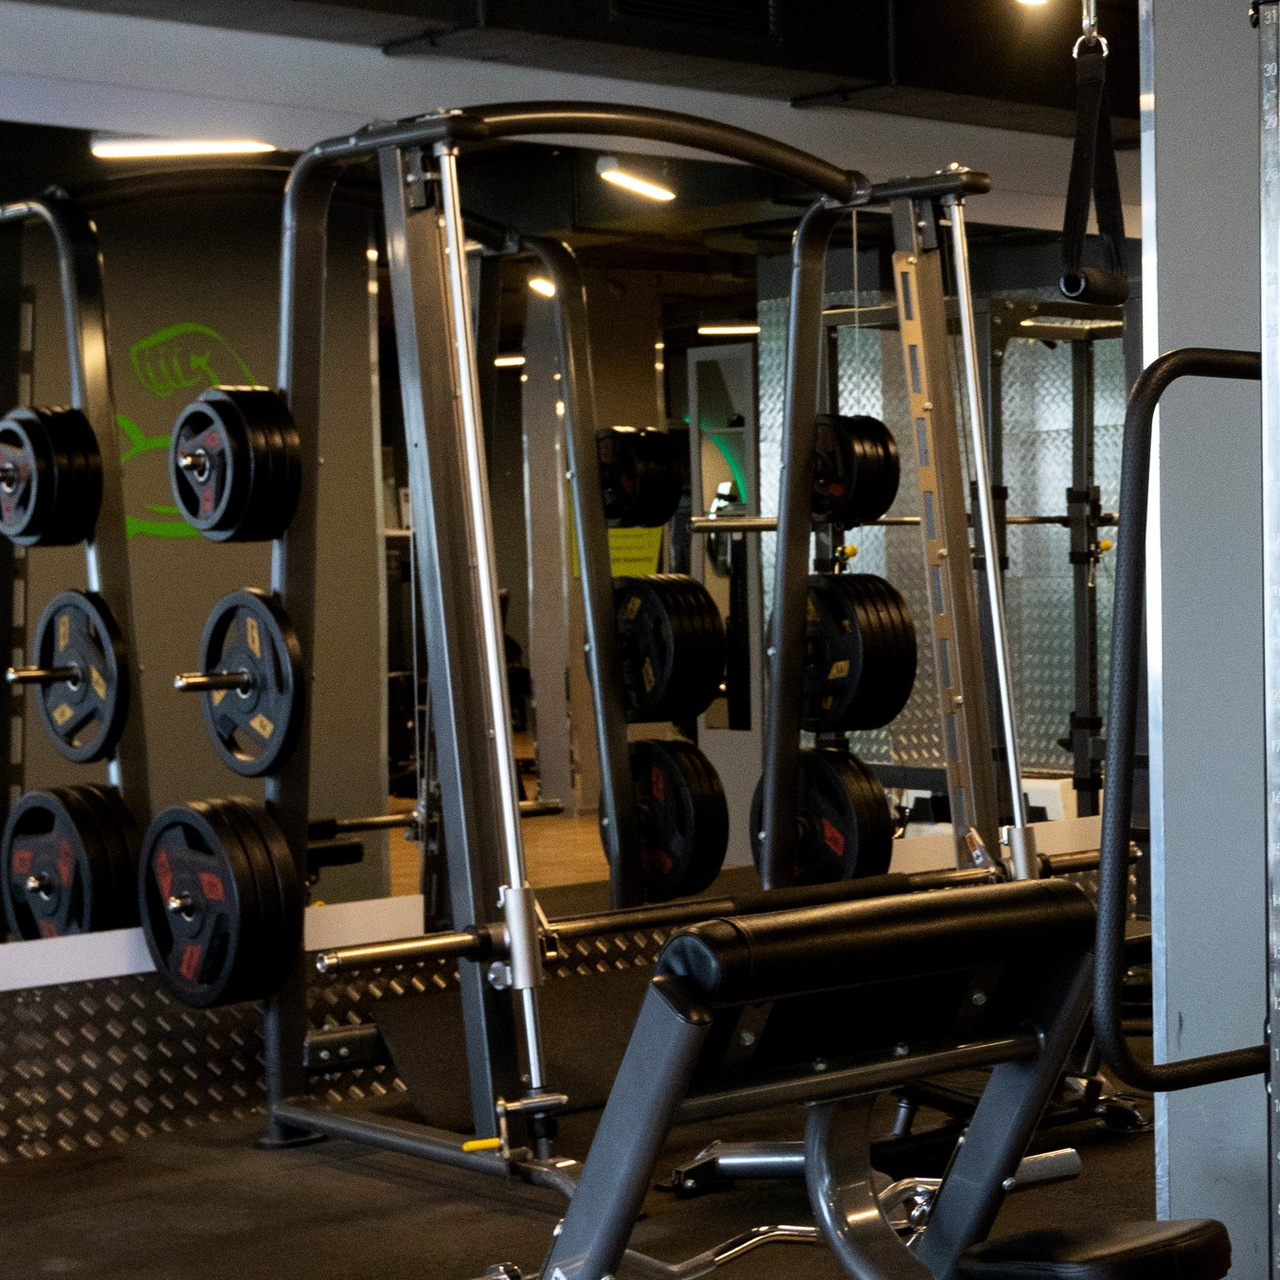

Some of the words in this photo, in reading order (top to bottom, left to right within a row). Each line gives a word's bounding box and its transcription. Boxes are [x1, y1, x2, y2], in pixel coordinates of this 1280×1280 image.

[1264, 11, 1276, 24] 31
[1264, 63, 1277, 76] 30
[1264, 116, 1277, 129] 29
